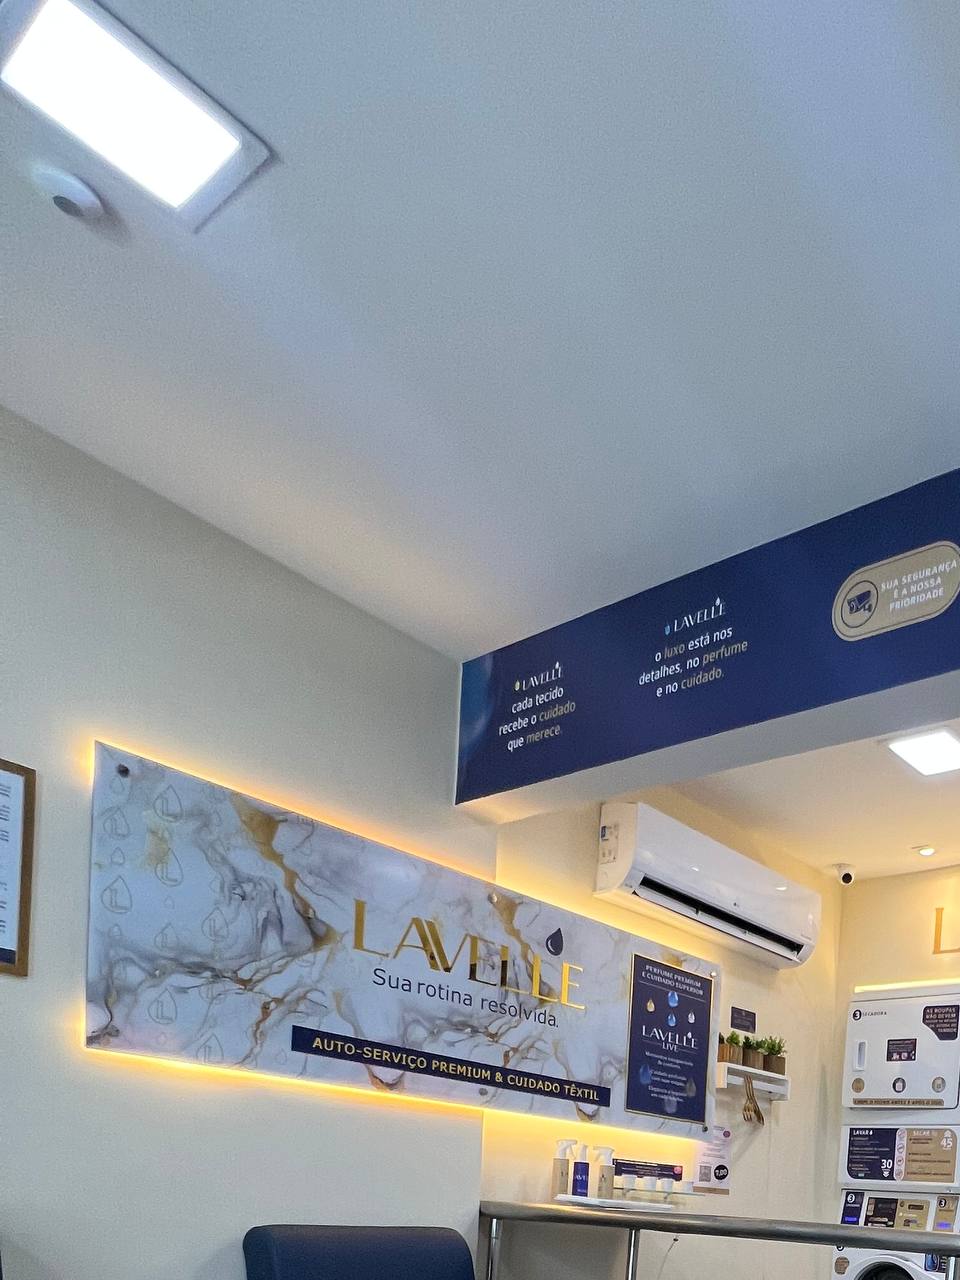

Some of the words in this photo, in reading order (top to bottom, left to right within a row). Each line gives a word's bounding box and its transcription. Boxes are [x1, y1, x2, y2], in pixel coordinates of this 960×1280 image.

[880, 578, 899, 592] SUA
[901, 559, 958, 585] SEGURANÇA
[901, 587, 908, 597] A
[910, 576, 942, 594] NOSSA
[889, 587, 945, 612] PRIORIDADE
[674, 600, 728, 633] LAVELLE
[655, 650, 663, 662] o
[664, 640, 686, 659] luxo
[688, 632, 710, 651] está
[713, 626, 733, 642] nos
[638, 661, 684, 686] detalhes,
[686, 656, 700, 670] no
[702, 640, 749, 666] perfume
[656, 687, 663, 698] e
[665, 680, 679, 694] no
[681, 666, 725, 691] cuidado.
[511, 695, 533, 714] cada
[535, 686, 564, 706] tecido
[498, 713, 529, 737] recebe
[530, 712, 538, 725] o
[539, 700, 577, 723] cuidado
[507, 736, 525, 753] que
[352, 898, 586, 1011] LAVELLE
[372, 967, 413, 994] Sua
[417, 977, 474, 1008] rotina
[480, 996, 560, 1029] resolvida.
[642, 1024, 698, 1050] LAVELLE
[662, 1043, 679, 1053] LIVE
[312, 1036, 428, 1071] AUTO-SERVIÇO
[431, 1059, 492, 1082] PREMIUM
[495, 1070, 504, 1084] &
[507, 1072, 561, 1095] CUIDADO
[563, 1081, 600, 1102] TÊXTIL
[940, 1138, 953, 1148] 45
[881, 1159, 893, 1169] 30
